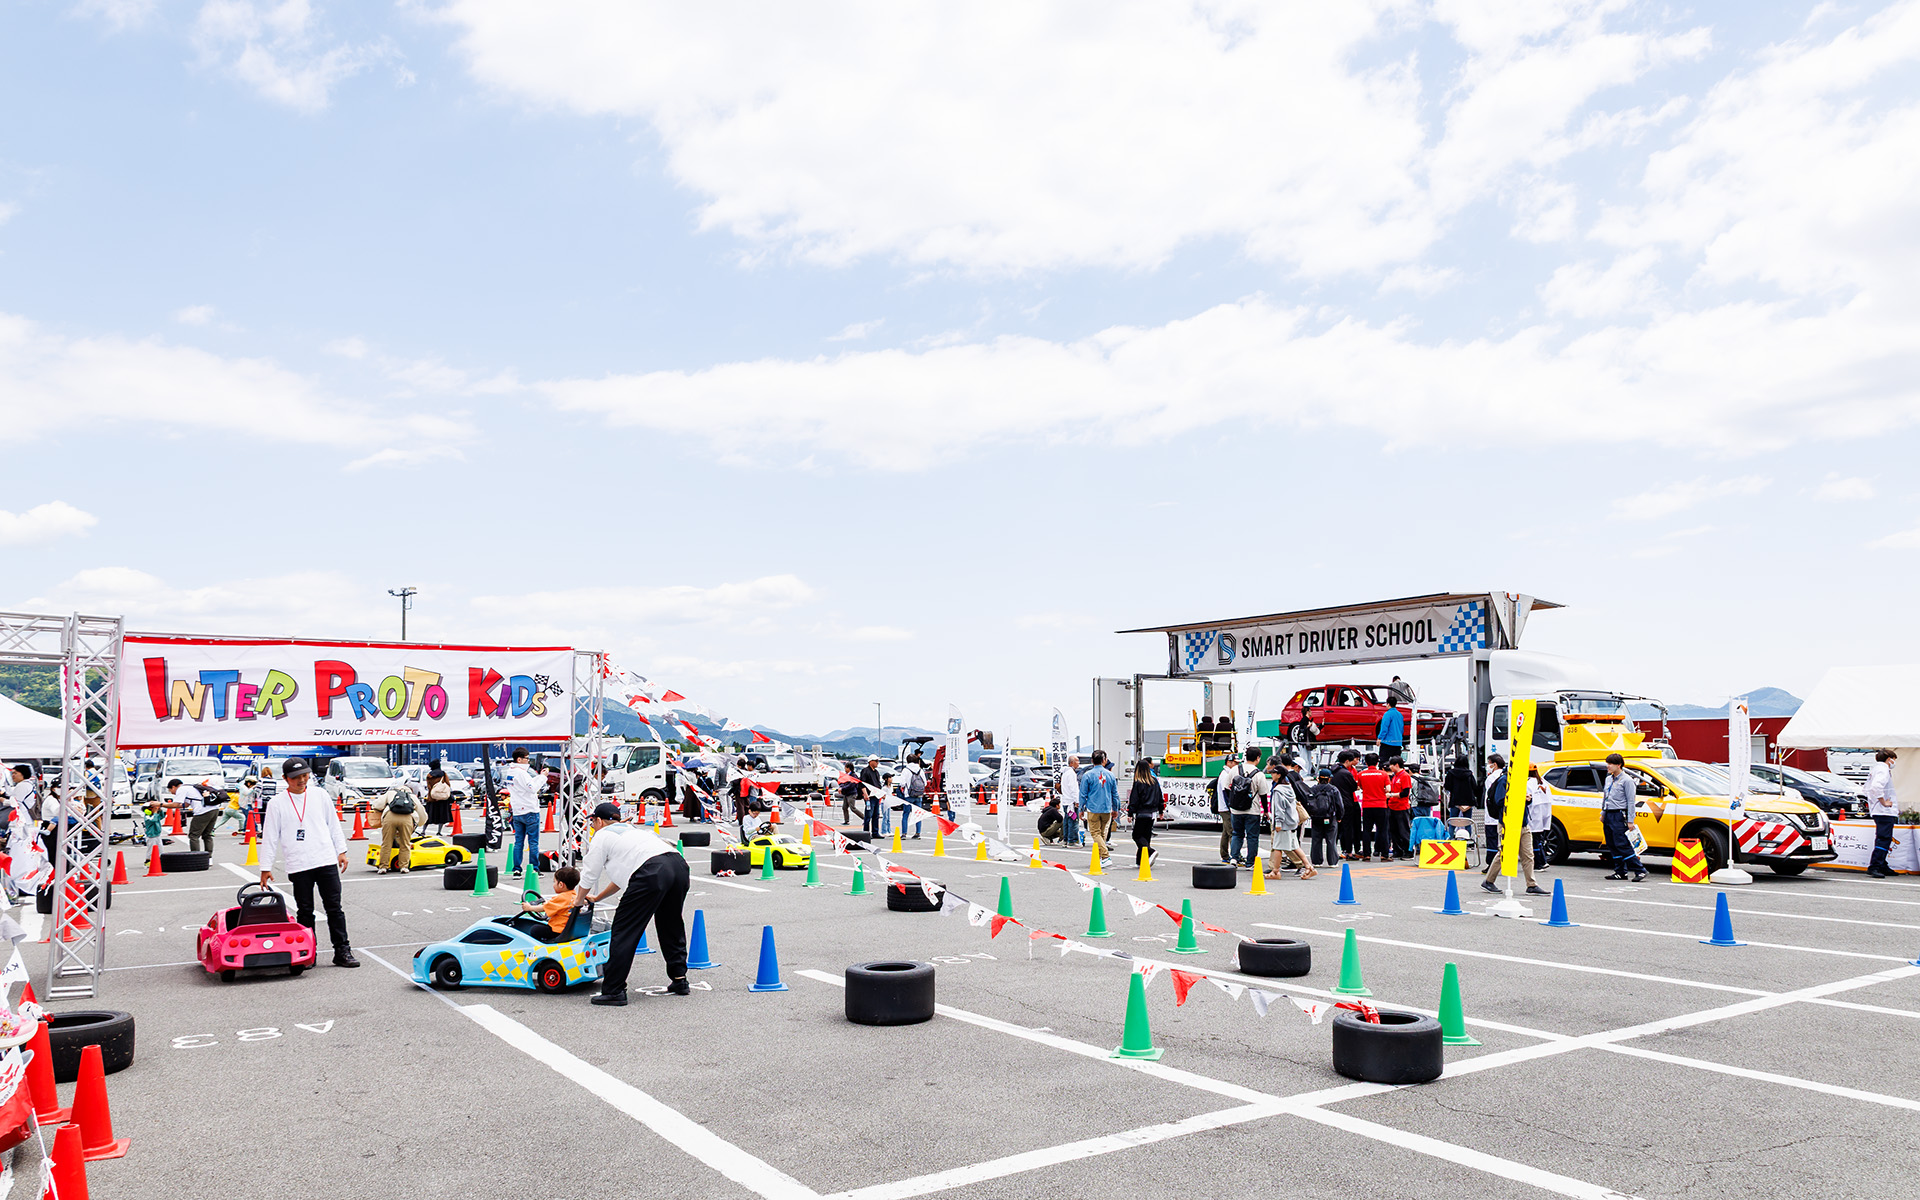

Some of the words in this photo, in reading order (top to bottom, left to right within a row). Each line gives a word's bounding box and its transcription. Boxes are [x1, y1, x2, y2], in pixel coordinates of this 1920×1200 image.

[1241, 633, 1293, 658] SMART
[1299, 626, 1359, 654] DRIVER
[1365, 618, 1437, 649] SCHOOL
[142, 656, 297, 722] INTER
[313, 659, 449, 722] PROTO
[312, 728, 363, 737] DRIVING
[364, 728, 420, 738] ATHLETE
[139, 743, 210, 759] MICHELIN
[221, 753, 267, 762] MICHELIN
[1837, 842, 1869, 851] スムーズに
[171, 1018, 335, 1049] A83
